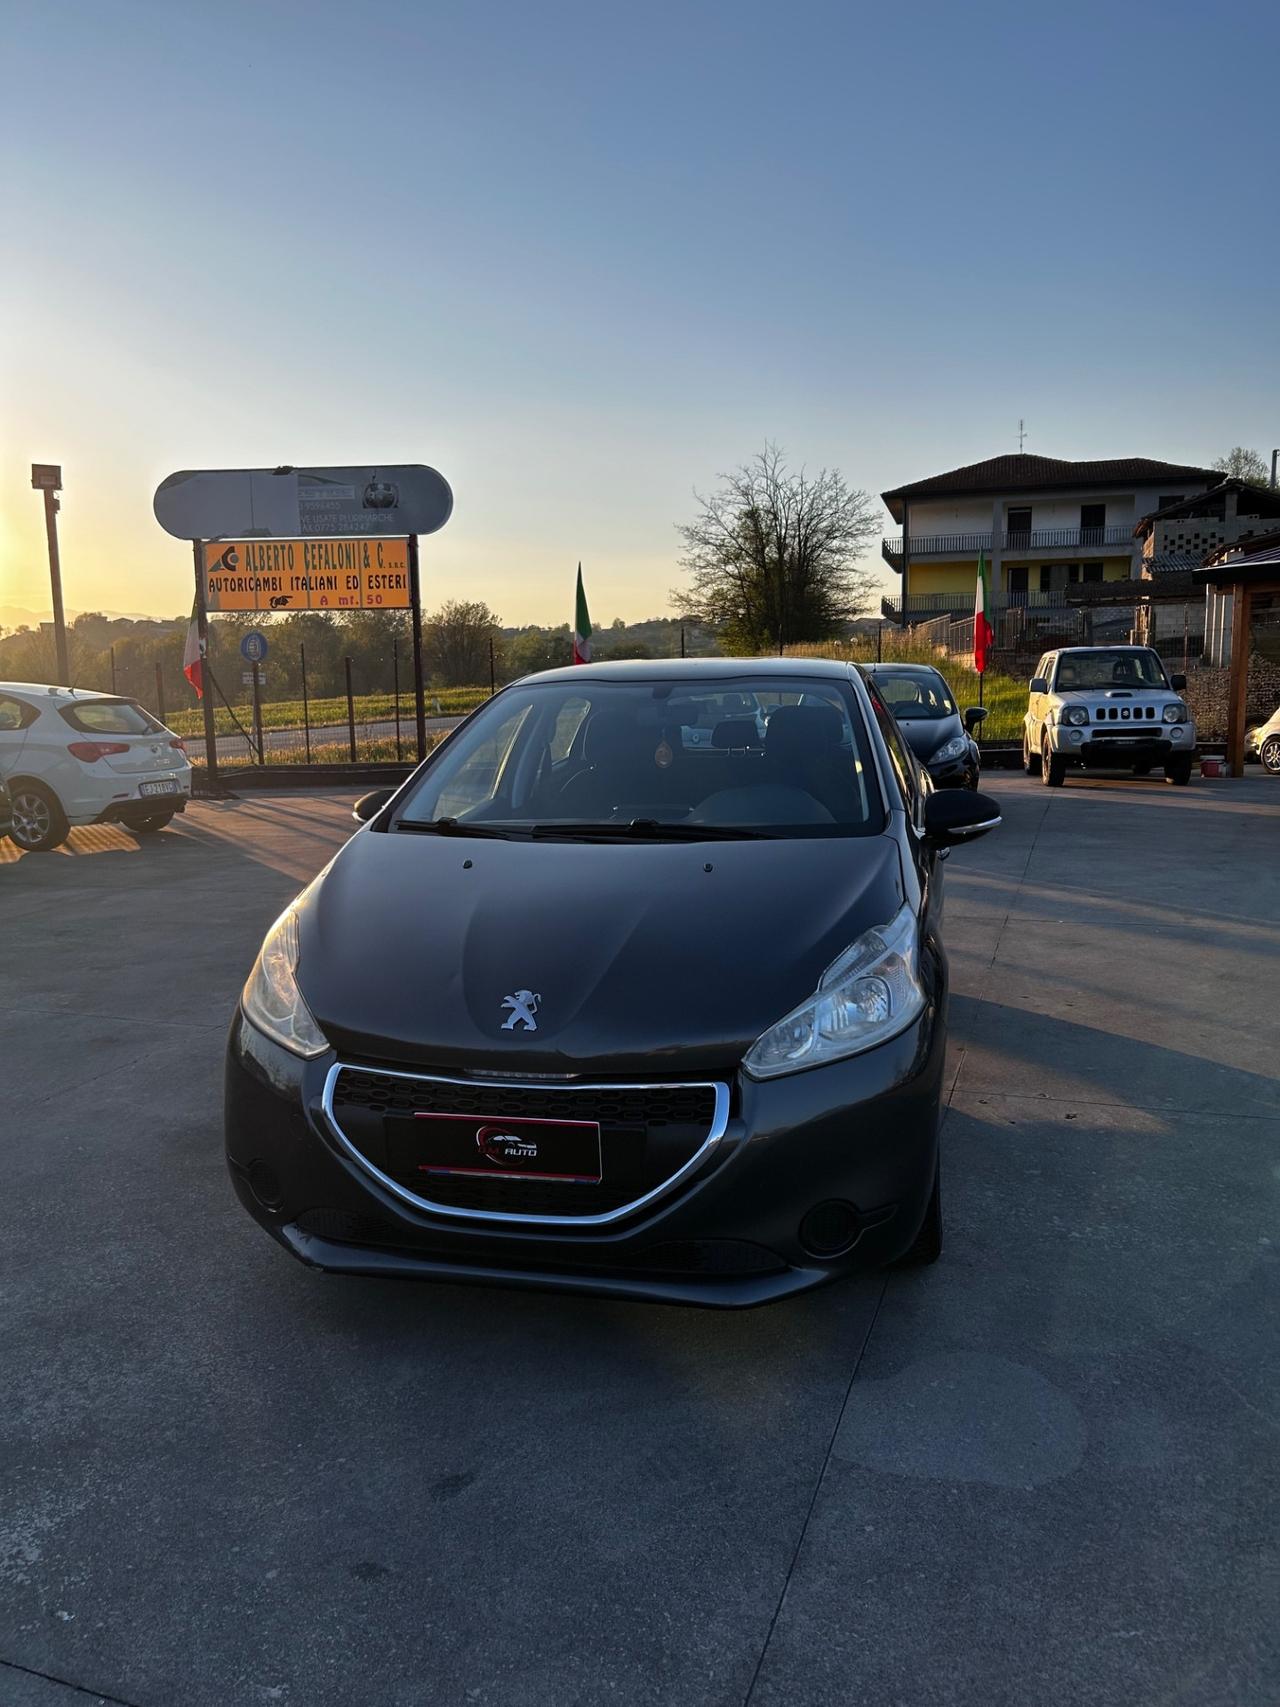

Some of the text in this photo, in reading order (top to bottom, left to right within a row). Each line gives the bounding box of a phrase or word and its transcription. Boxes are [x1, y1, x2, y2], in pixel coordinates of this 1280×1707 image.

[246, 543, 295, 572] ALBERTO
[304, 541, 356, 571] CEFALONI
[363, 543, 371, 569] &
[209, 574, 406, 593] AUTORICAMBI ITALIANI ED ESTERI
[320, 595, 328, 606] A
[367, 595, 383, 605] 50
[504, 1148, 537, 1157] AUTO
